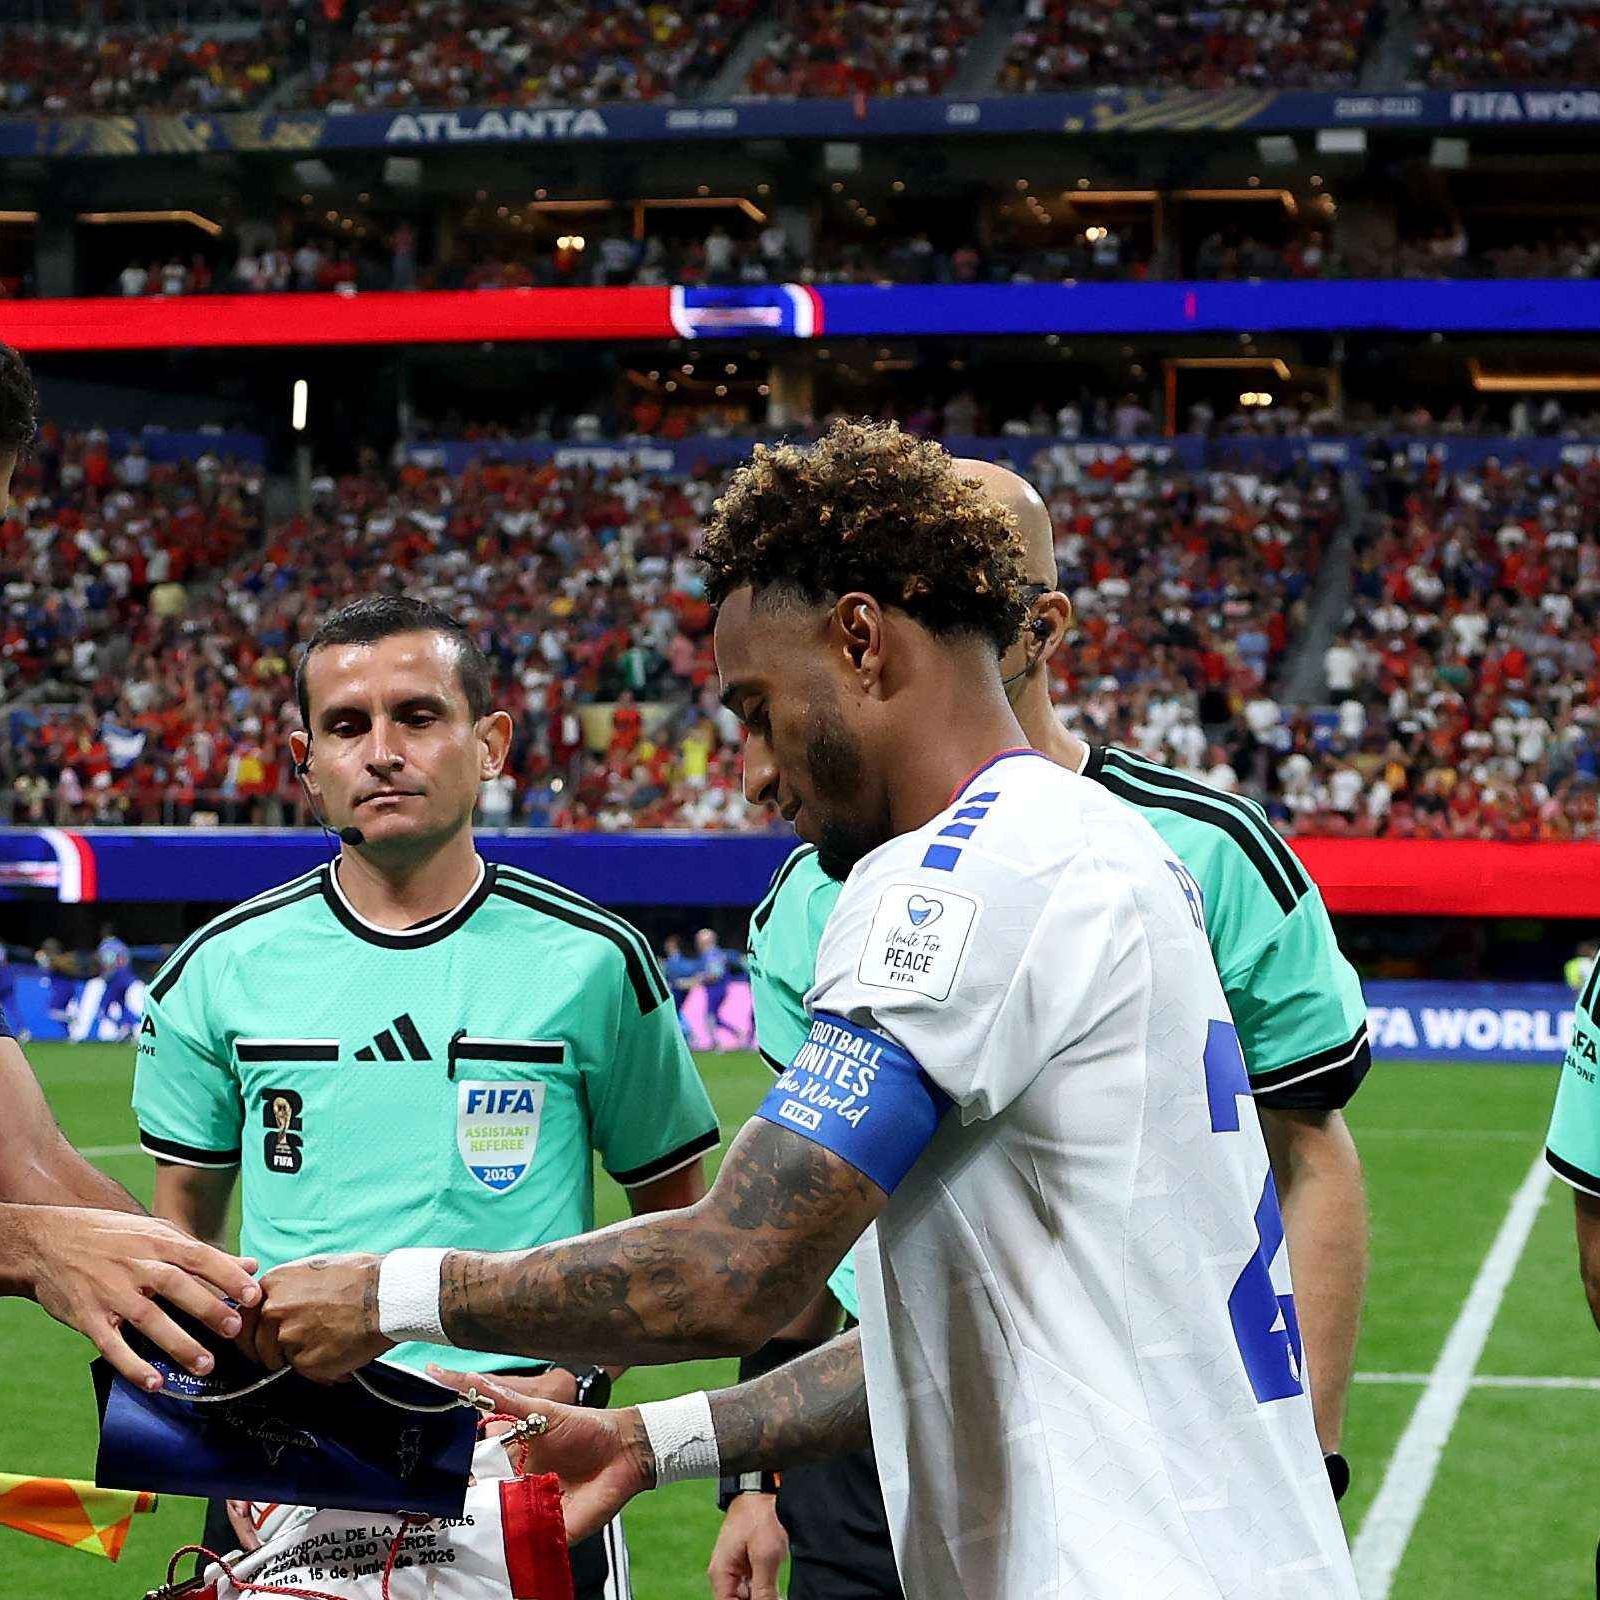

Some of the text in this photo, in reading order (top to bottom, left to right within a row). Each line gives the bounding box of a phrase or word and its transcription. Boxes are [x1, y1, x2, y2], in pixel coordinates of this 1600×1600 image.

[1450, 91, 1522, 121] FIFA
[386, 109, 608, 141] ATLANTA
[885, 926, 942, 952] Unite For
[885, 947, 934, 974] PEACE
[890, 971, 914, 983] FIFA
[809, 1020, 883, 1071] FOOTBALL
[794, 1042, 875, 1097] UNITES
[466, 1089, 534, 1114] FIFA
[783, 1103, 815, 1125] FIFA
[799, 1077, 870, 1128] World
[465, 1126, 530, 1138] ASSISTANT
[470, 1139, 525, 1152] REFEREE
[273, 1155, 294, 1168] FIFA
[483, 1168, 516, 1182] 2026
[274, 1531, 341, 1564] MUNDIAL
[345, 1527, 367, 1542] DE
[371, 1525, 394, 1538] LA
[308, 1567, 323, 1581] 15
[330, 1564, 348, 1580] de
[419, 1548, 456, 1566] 2026
